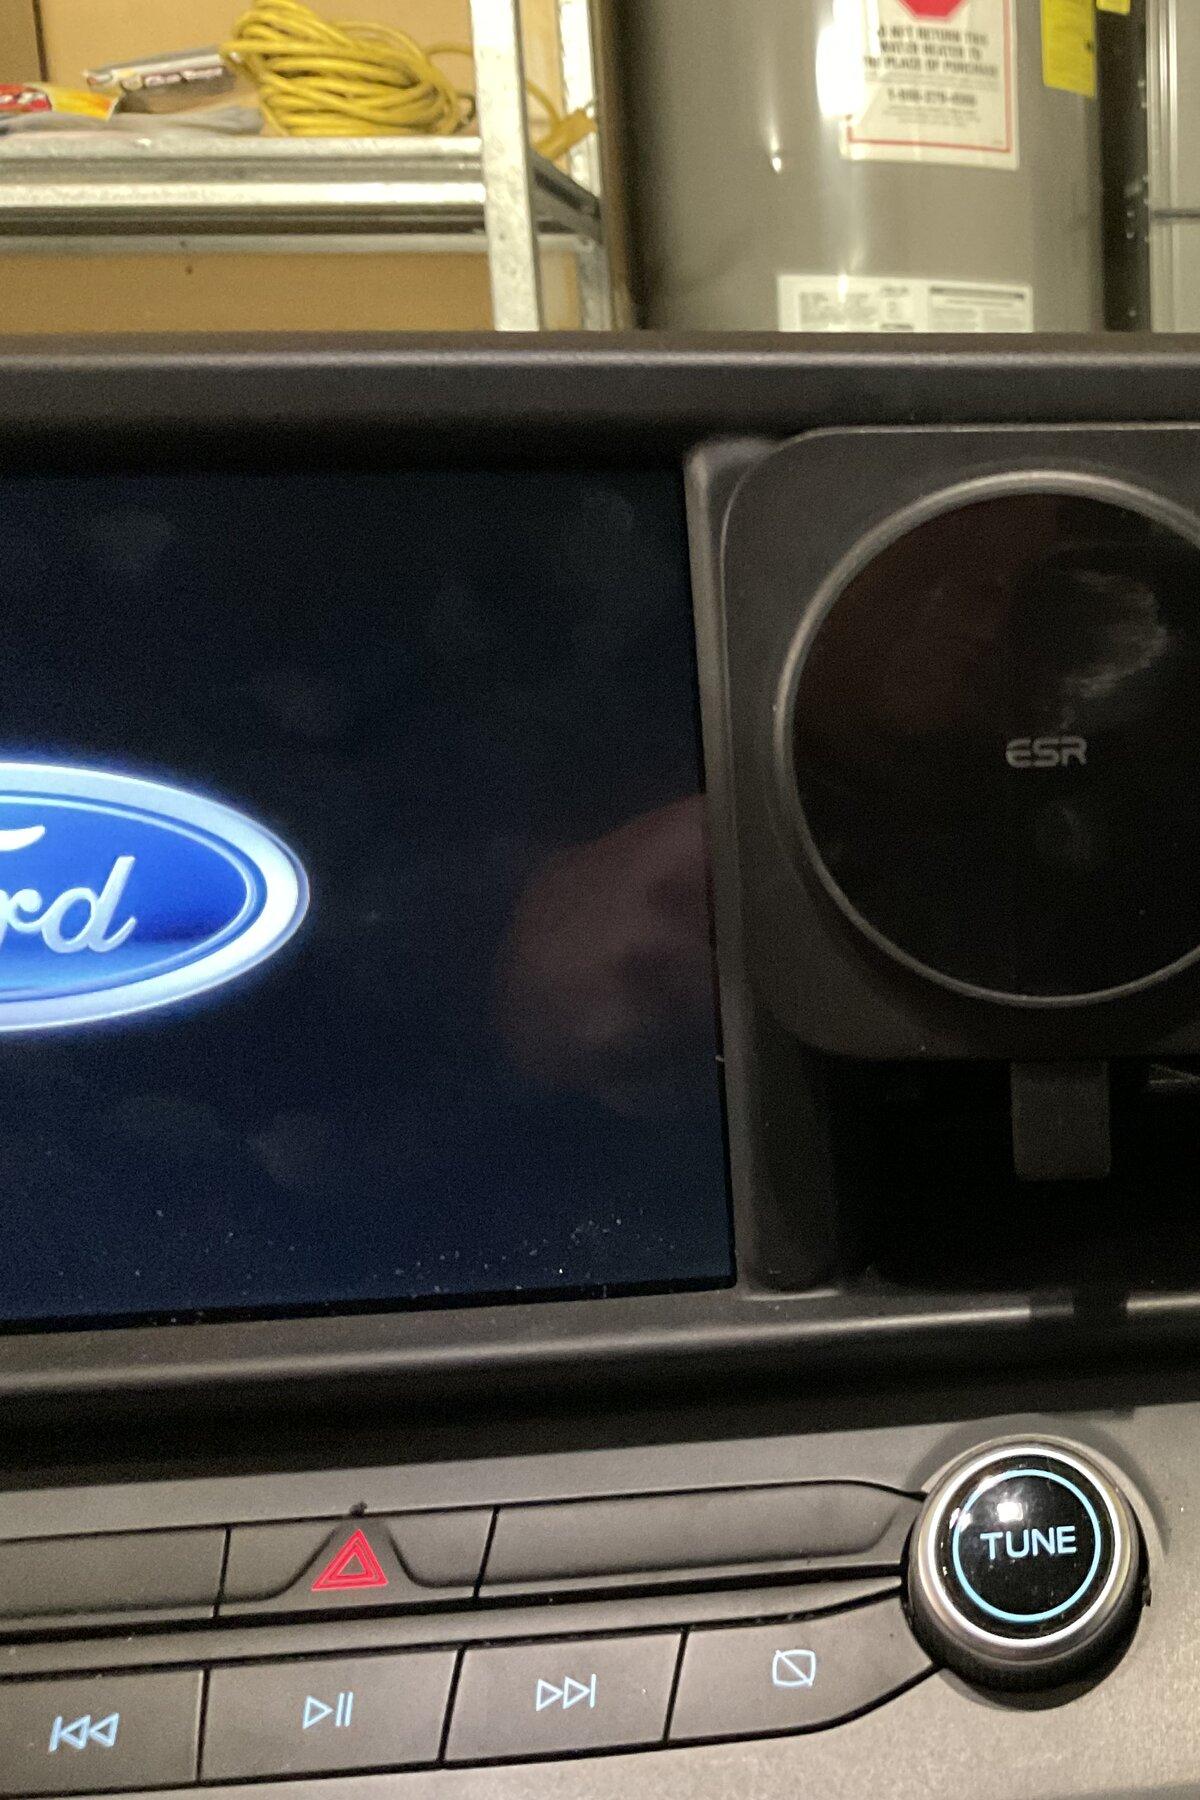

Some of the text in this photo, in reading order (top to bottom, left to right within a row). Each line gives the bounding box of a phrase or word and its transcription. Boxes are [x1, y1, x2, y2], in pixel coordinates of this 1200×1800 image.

[1005, 736, 1088, 767] ESR
[0, 825, 137, 953] rd
[979, 1525, 1077, 1560] TUNE
